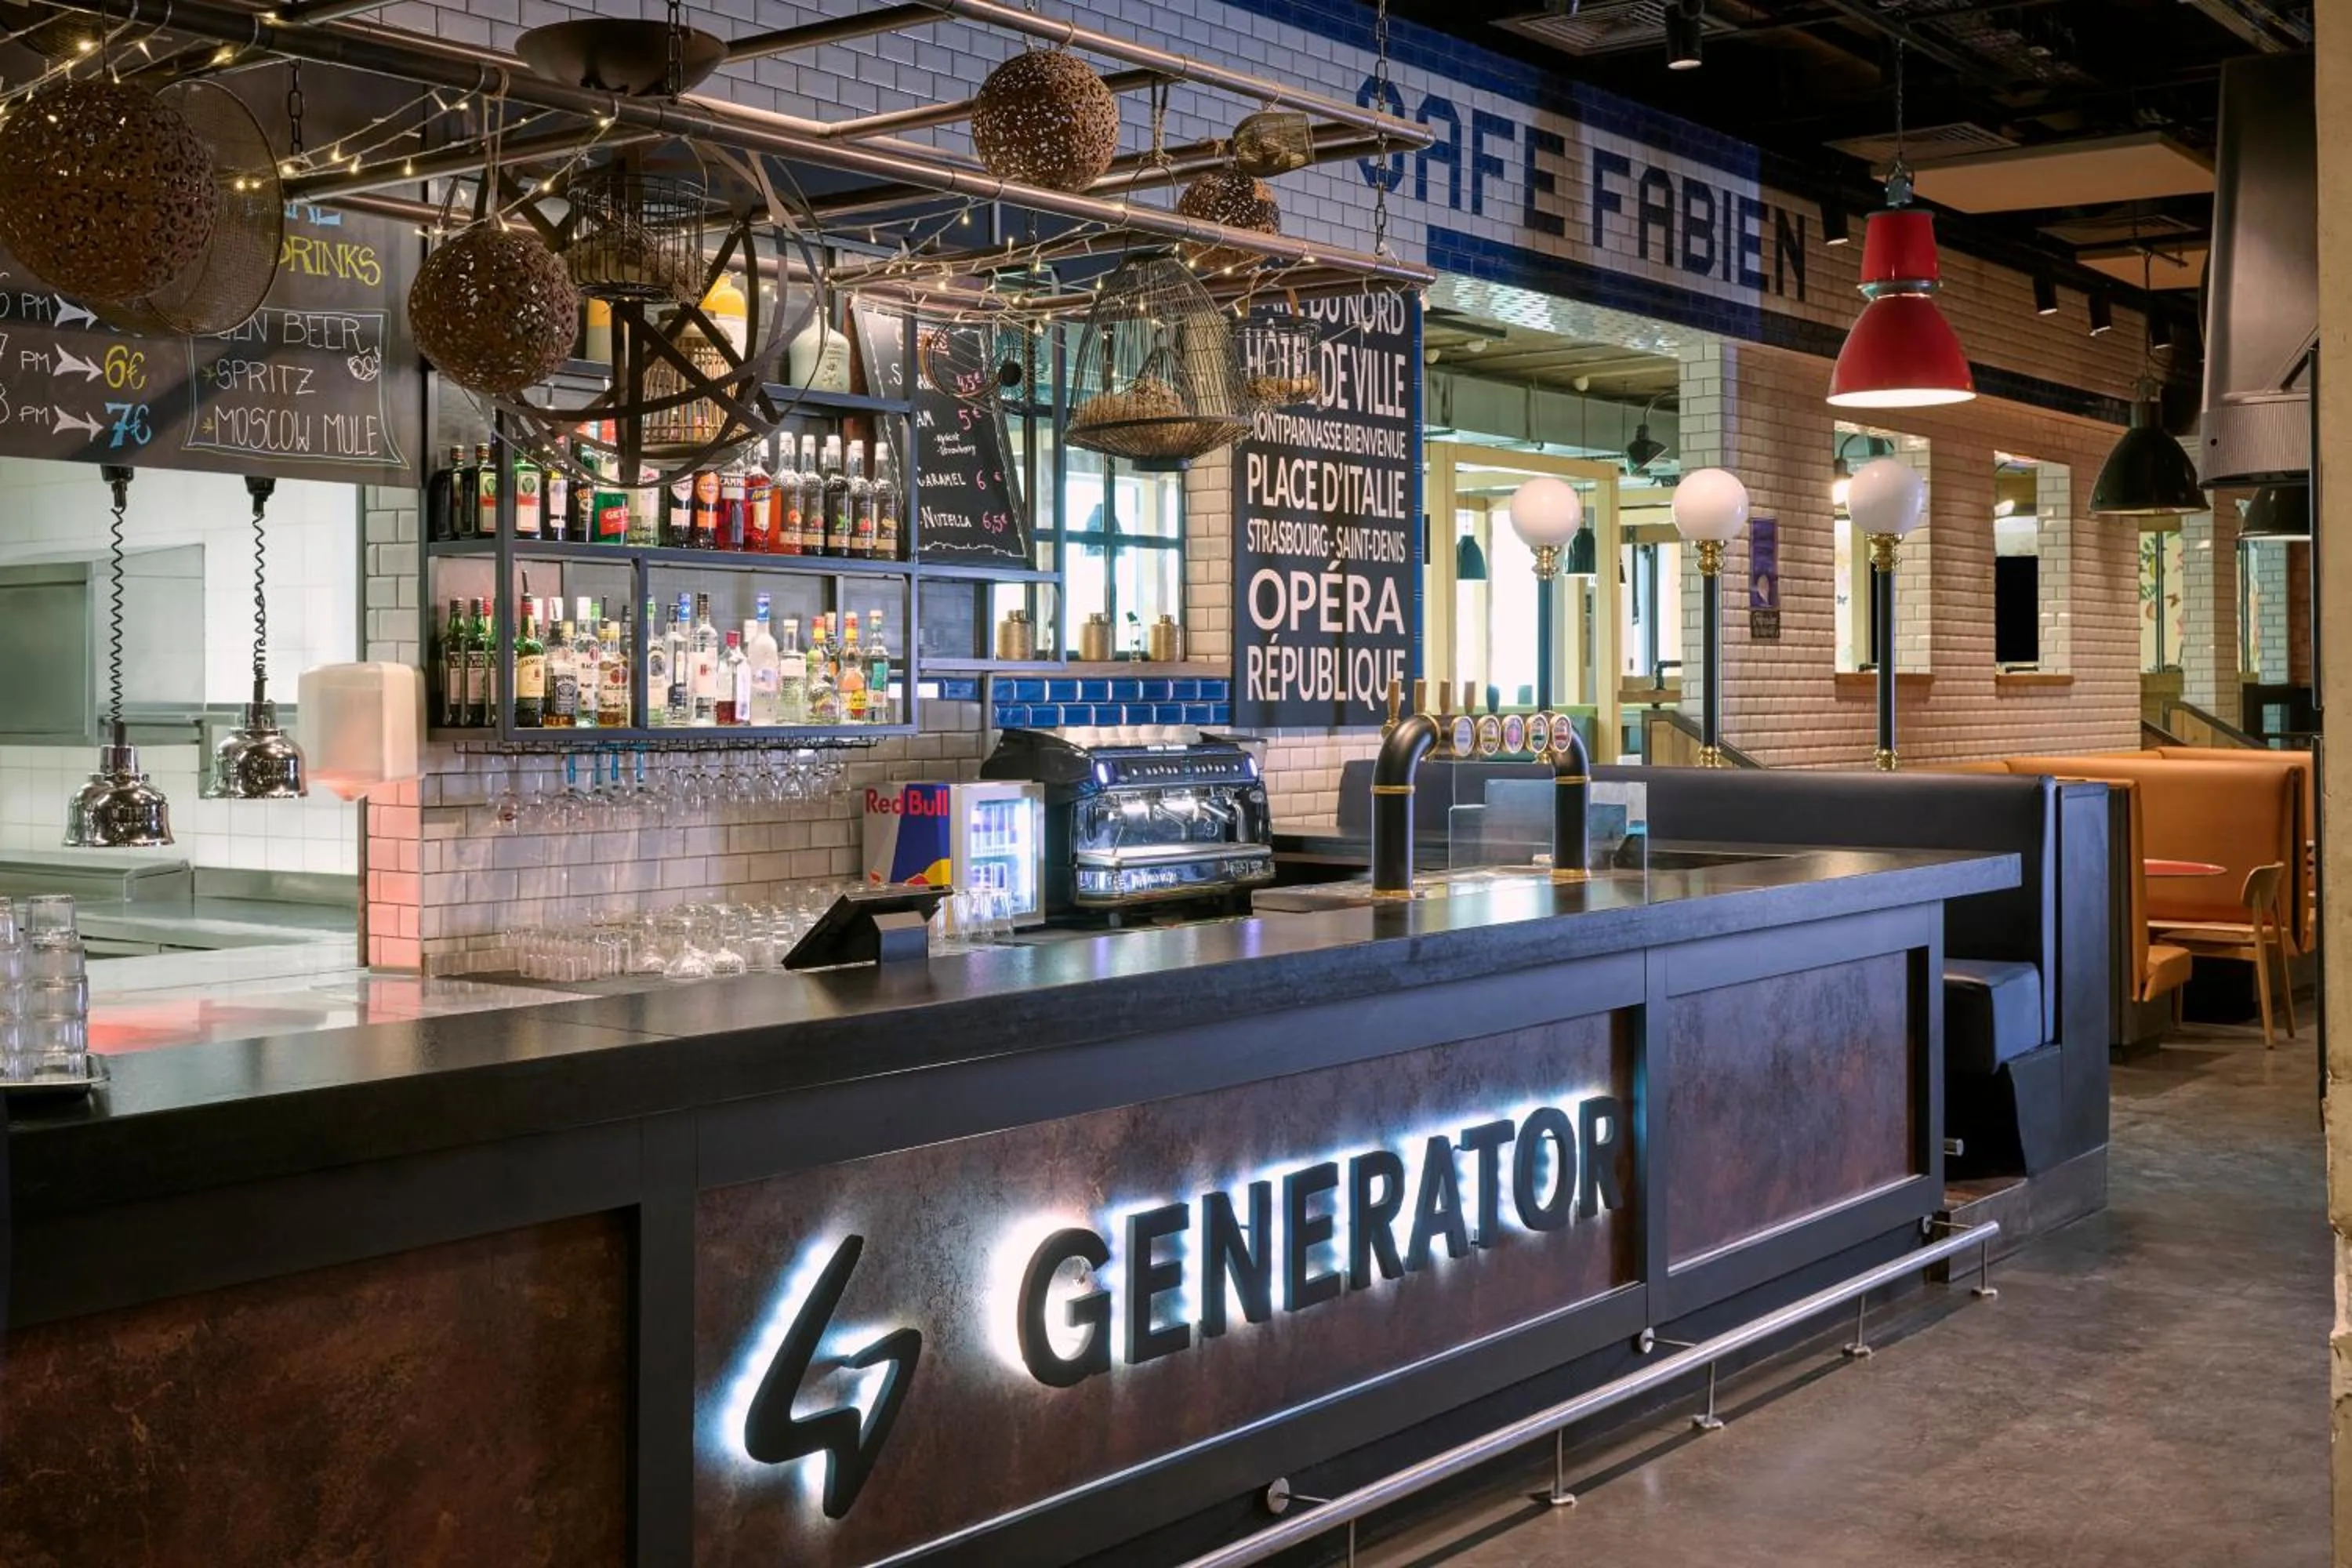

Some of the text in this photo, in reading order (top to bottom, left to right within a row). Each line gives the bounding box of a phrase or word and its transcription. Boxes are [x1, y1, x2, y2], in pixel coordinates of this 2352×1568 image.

[1592, 147, 1803, 303] FABIEN
[21, 292, 52, 321] PM
[1345, 292, 1406, 336] NORD
[283, 314, 370, 353] BEER
[20, 350, 51, 373] PM
[104, 344, 147, 390] 6€
[216, 359, 315, 394] SPRITZ
[1321, 340, 1349, 410] DE
[1351, 346, 1406, 418] VILLE
[19, 401, 152, 448] PM 7€
[215, 405, 378, 456] MOSCOW MULE
[1344, 426, 1406, 460] BIENVENUE
[1247, 452, 1406, 520] PLACE D'ITALIE
[1247, 518, 1328, 557] STRASBOURG
[1336, 525, 1406, 563] SAINT-DENIS
[1247, 560, 1406, 635] OPÉRA
[1247, 633, 1406, 711] RÉPUBLIQUE
[865, 788, 949, 816] Red Bull
[1016, 1094, 1624, 1389] GENERATOR
